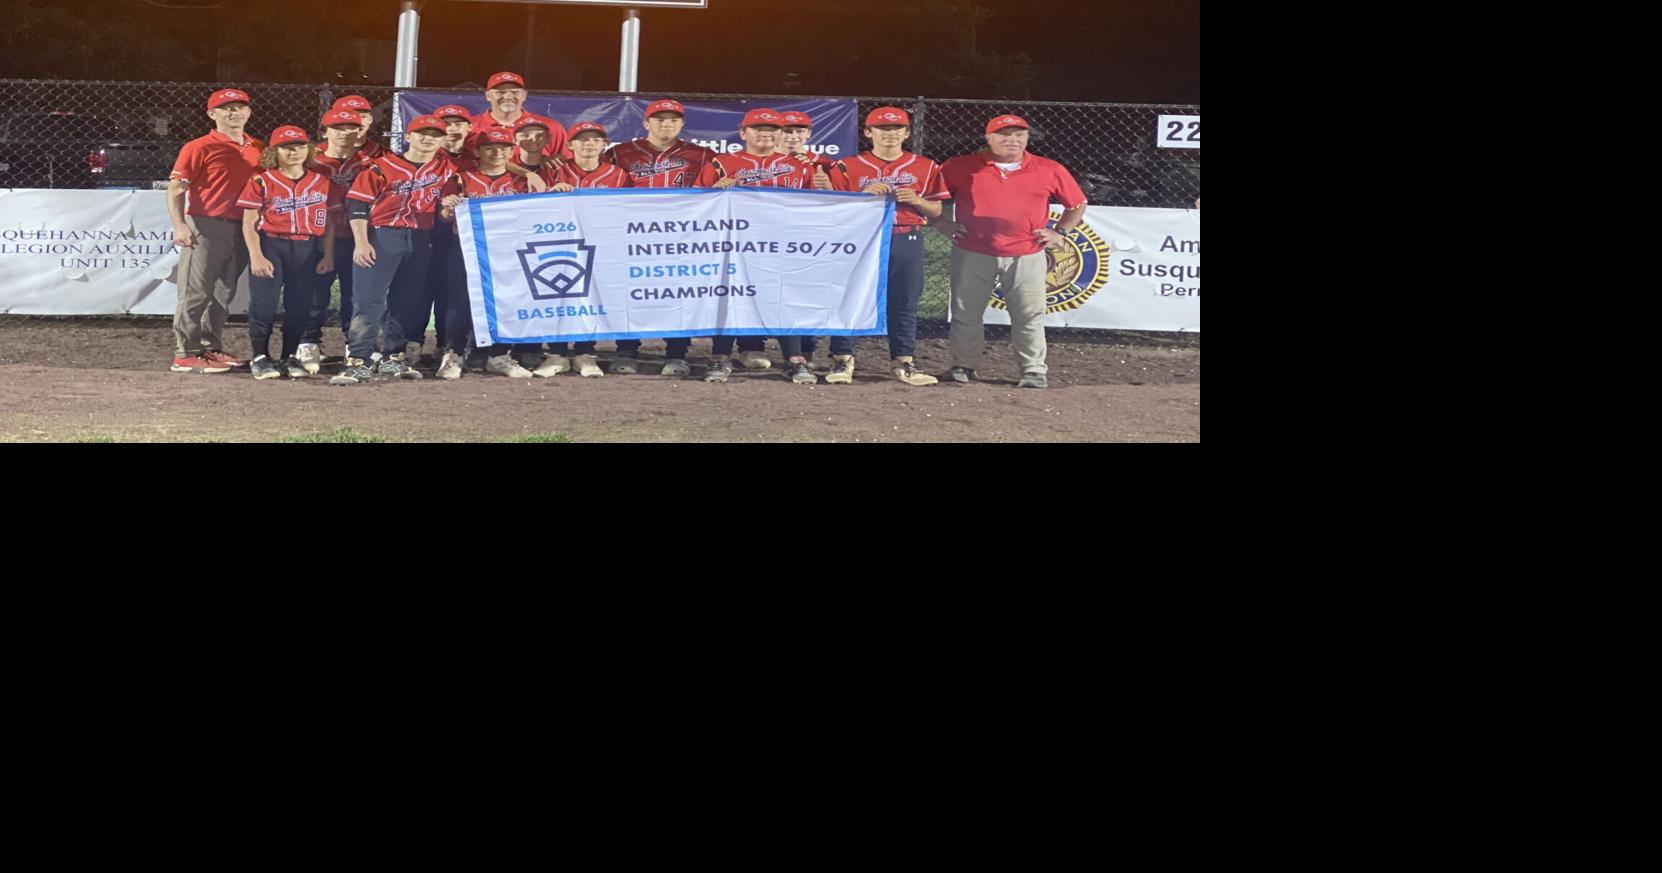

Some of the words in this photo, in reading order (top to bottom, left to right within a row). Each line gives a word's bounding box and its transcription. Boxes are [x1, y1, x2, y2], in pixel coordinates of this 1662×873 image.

[1166, 121, 1200, 142] 22
[315, 208, 326, 227] 8
[533, 222, 577, 234] 2026
[627, 219, 750, 234] MARYLAND
[0, 229, 129, 241] QUEHANNA
[1, 244, 84, 254] LEGION
[89, 244, 179, 255] AUXILIA
[628, 241, 779, 256] INTERMEDIATE
[786, 241, 857, 256] 50/70
[1160, 235, 1200, 253] Am
[61, 258, 112, 268] UNIT
[121, 258, 150, 269] 135
[629, 264, 720, 278] DISTRICT
[726, 263, 737, 275] 5
[1119, 258, 1200, 283] Susqu
[630, 285, 757, 300] CHAMPIONS
[517, 304, 608, 320] BASEBALL
